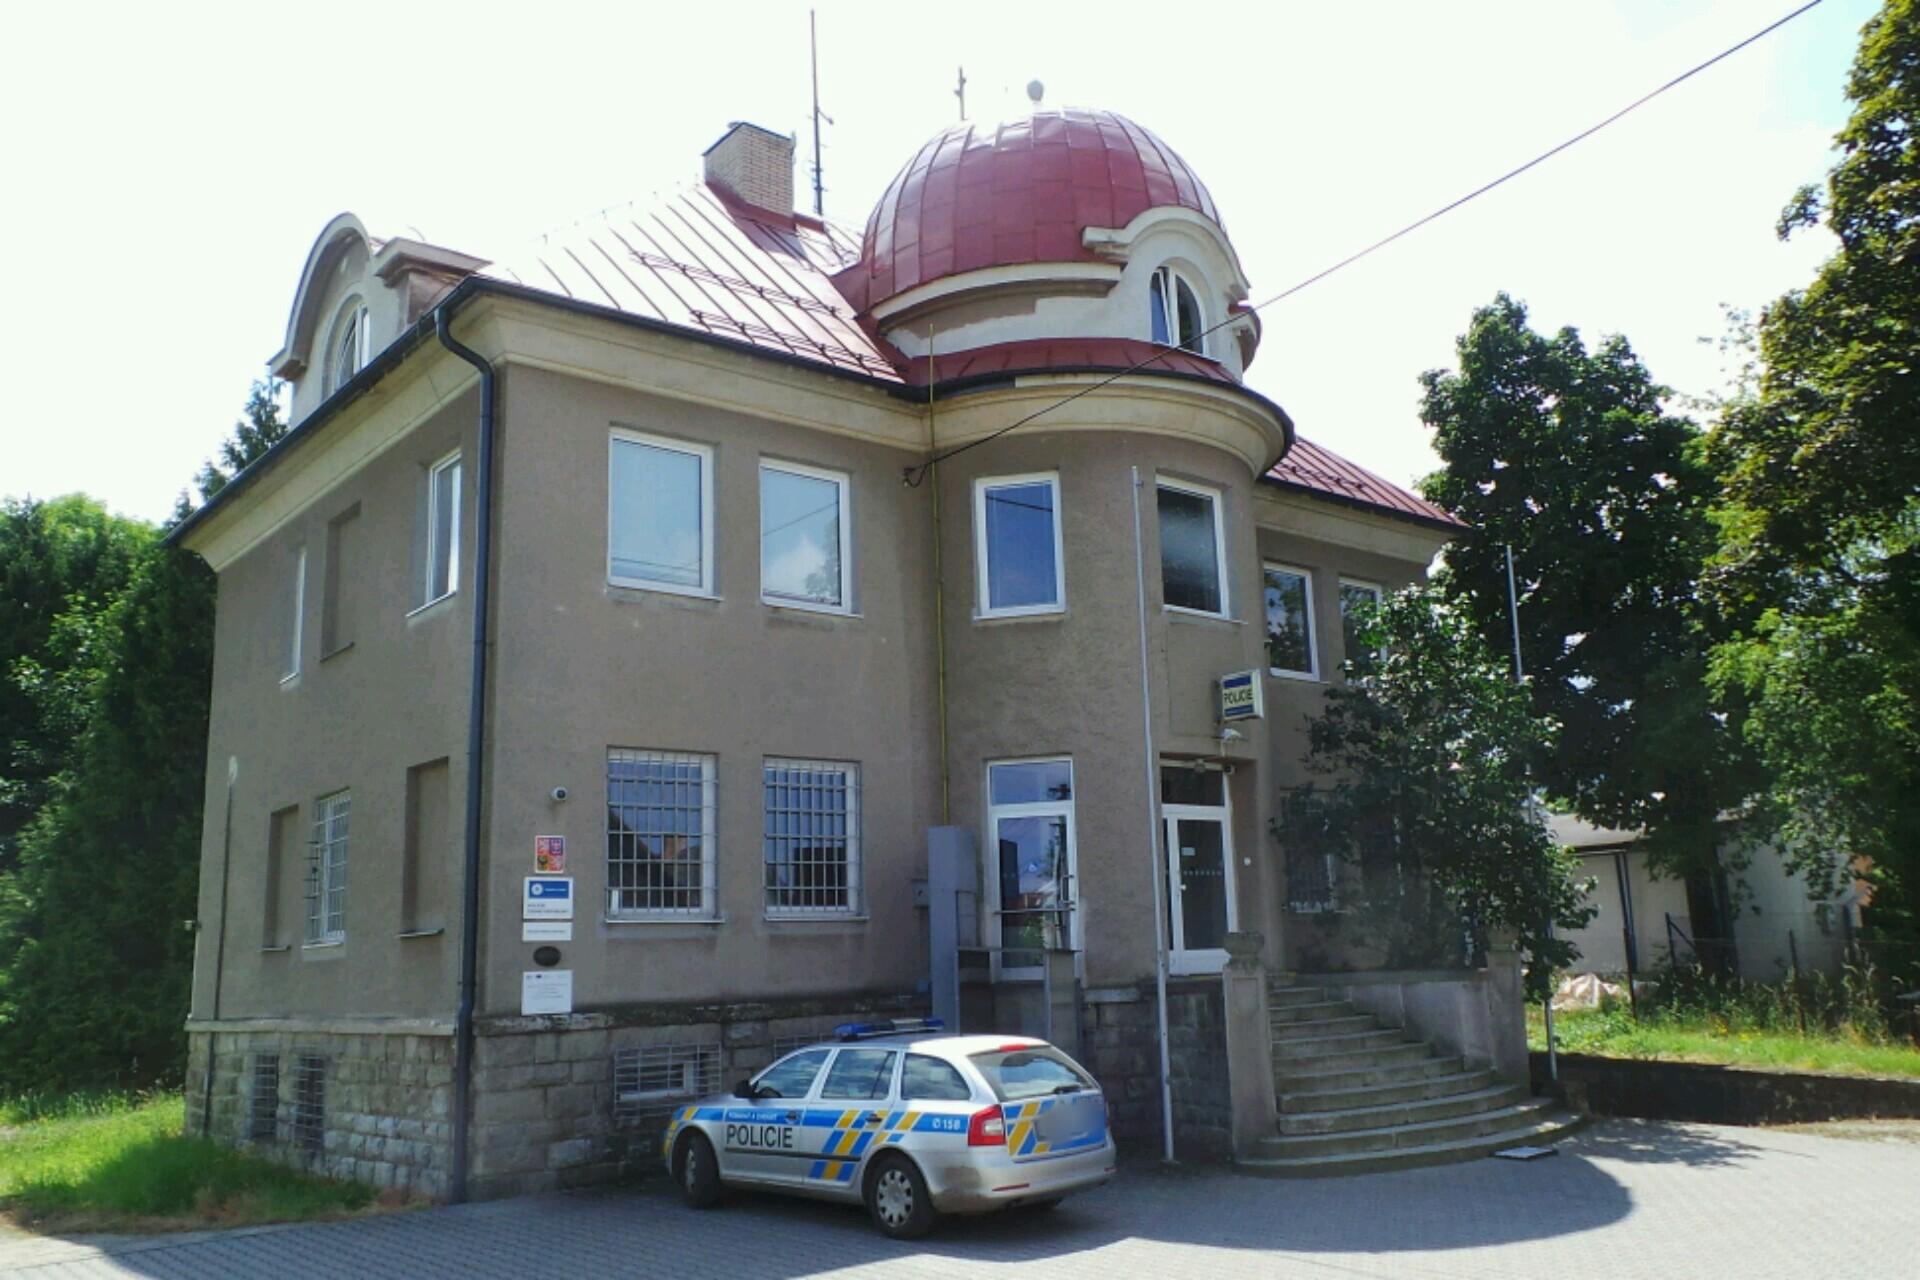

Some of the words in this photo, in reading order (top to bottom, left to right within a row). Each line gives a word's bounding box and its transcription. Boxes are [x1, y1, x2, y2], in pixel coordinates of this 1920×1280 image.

[1223, 689, 1253, 705] POLICIE
[943, 1118, 961, 1131] 158
[726, 1124, 793, 1149] POLICIE
